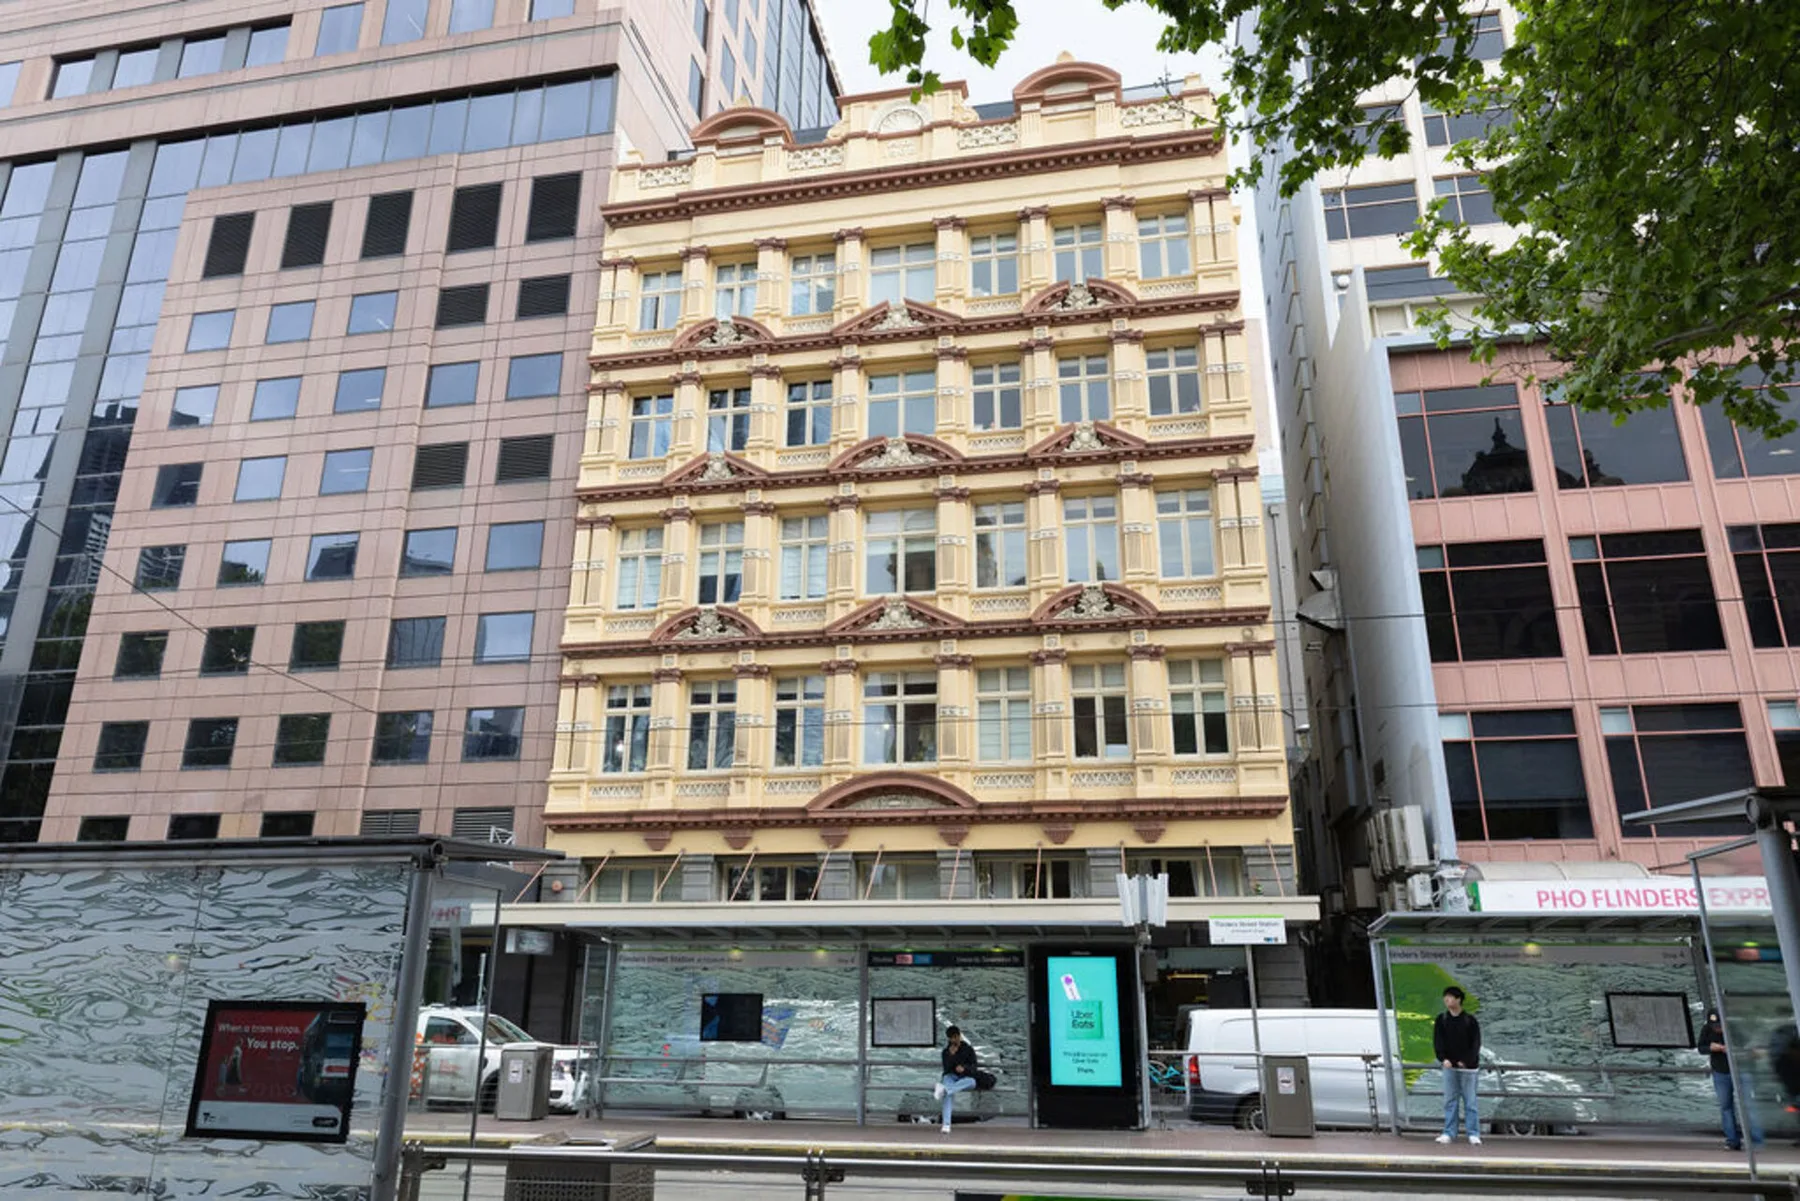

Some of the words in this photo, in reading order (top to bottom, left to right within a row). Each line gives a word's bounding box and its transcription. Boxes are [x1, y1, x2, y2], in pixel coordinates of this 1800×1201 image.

[1537, 889, 1586, 909] PHO
[1593, 887, 1699, 908] FLINDERS
[1071, 1010, 1093, 1019] Uber
[1072, 1020, 1095, 1029] Eats
[247, 1036, 268, 1049] You
[270, 1039, 299, 1052] stop.
